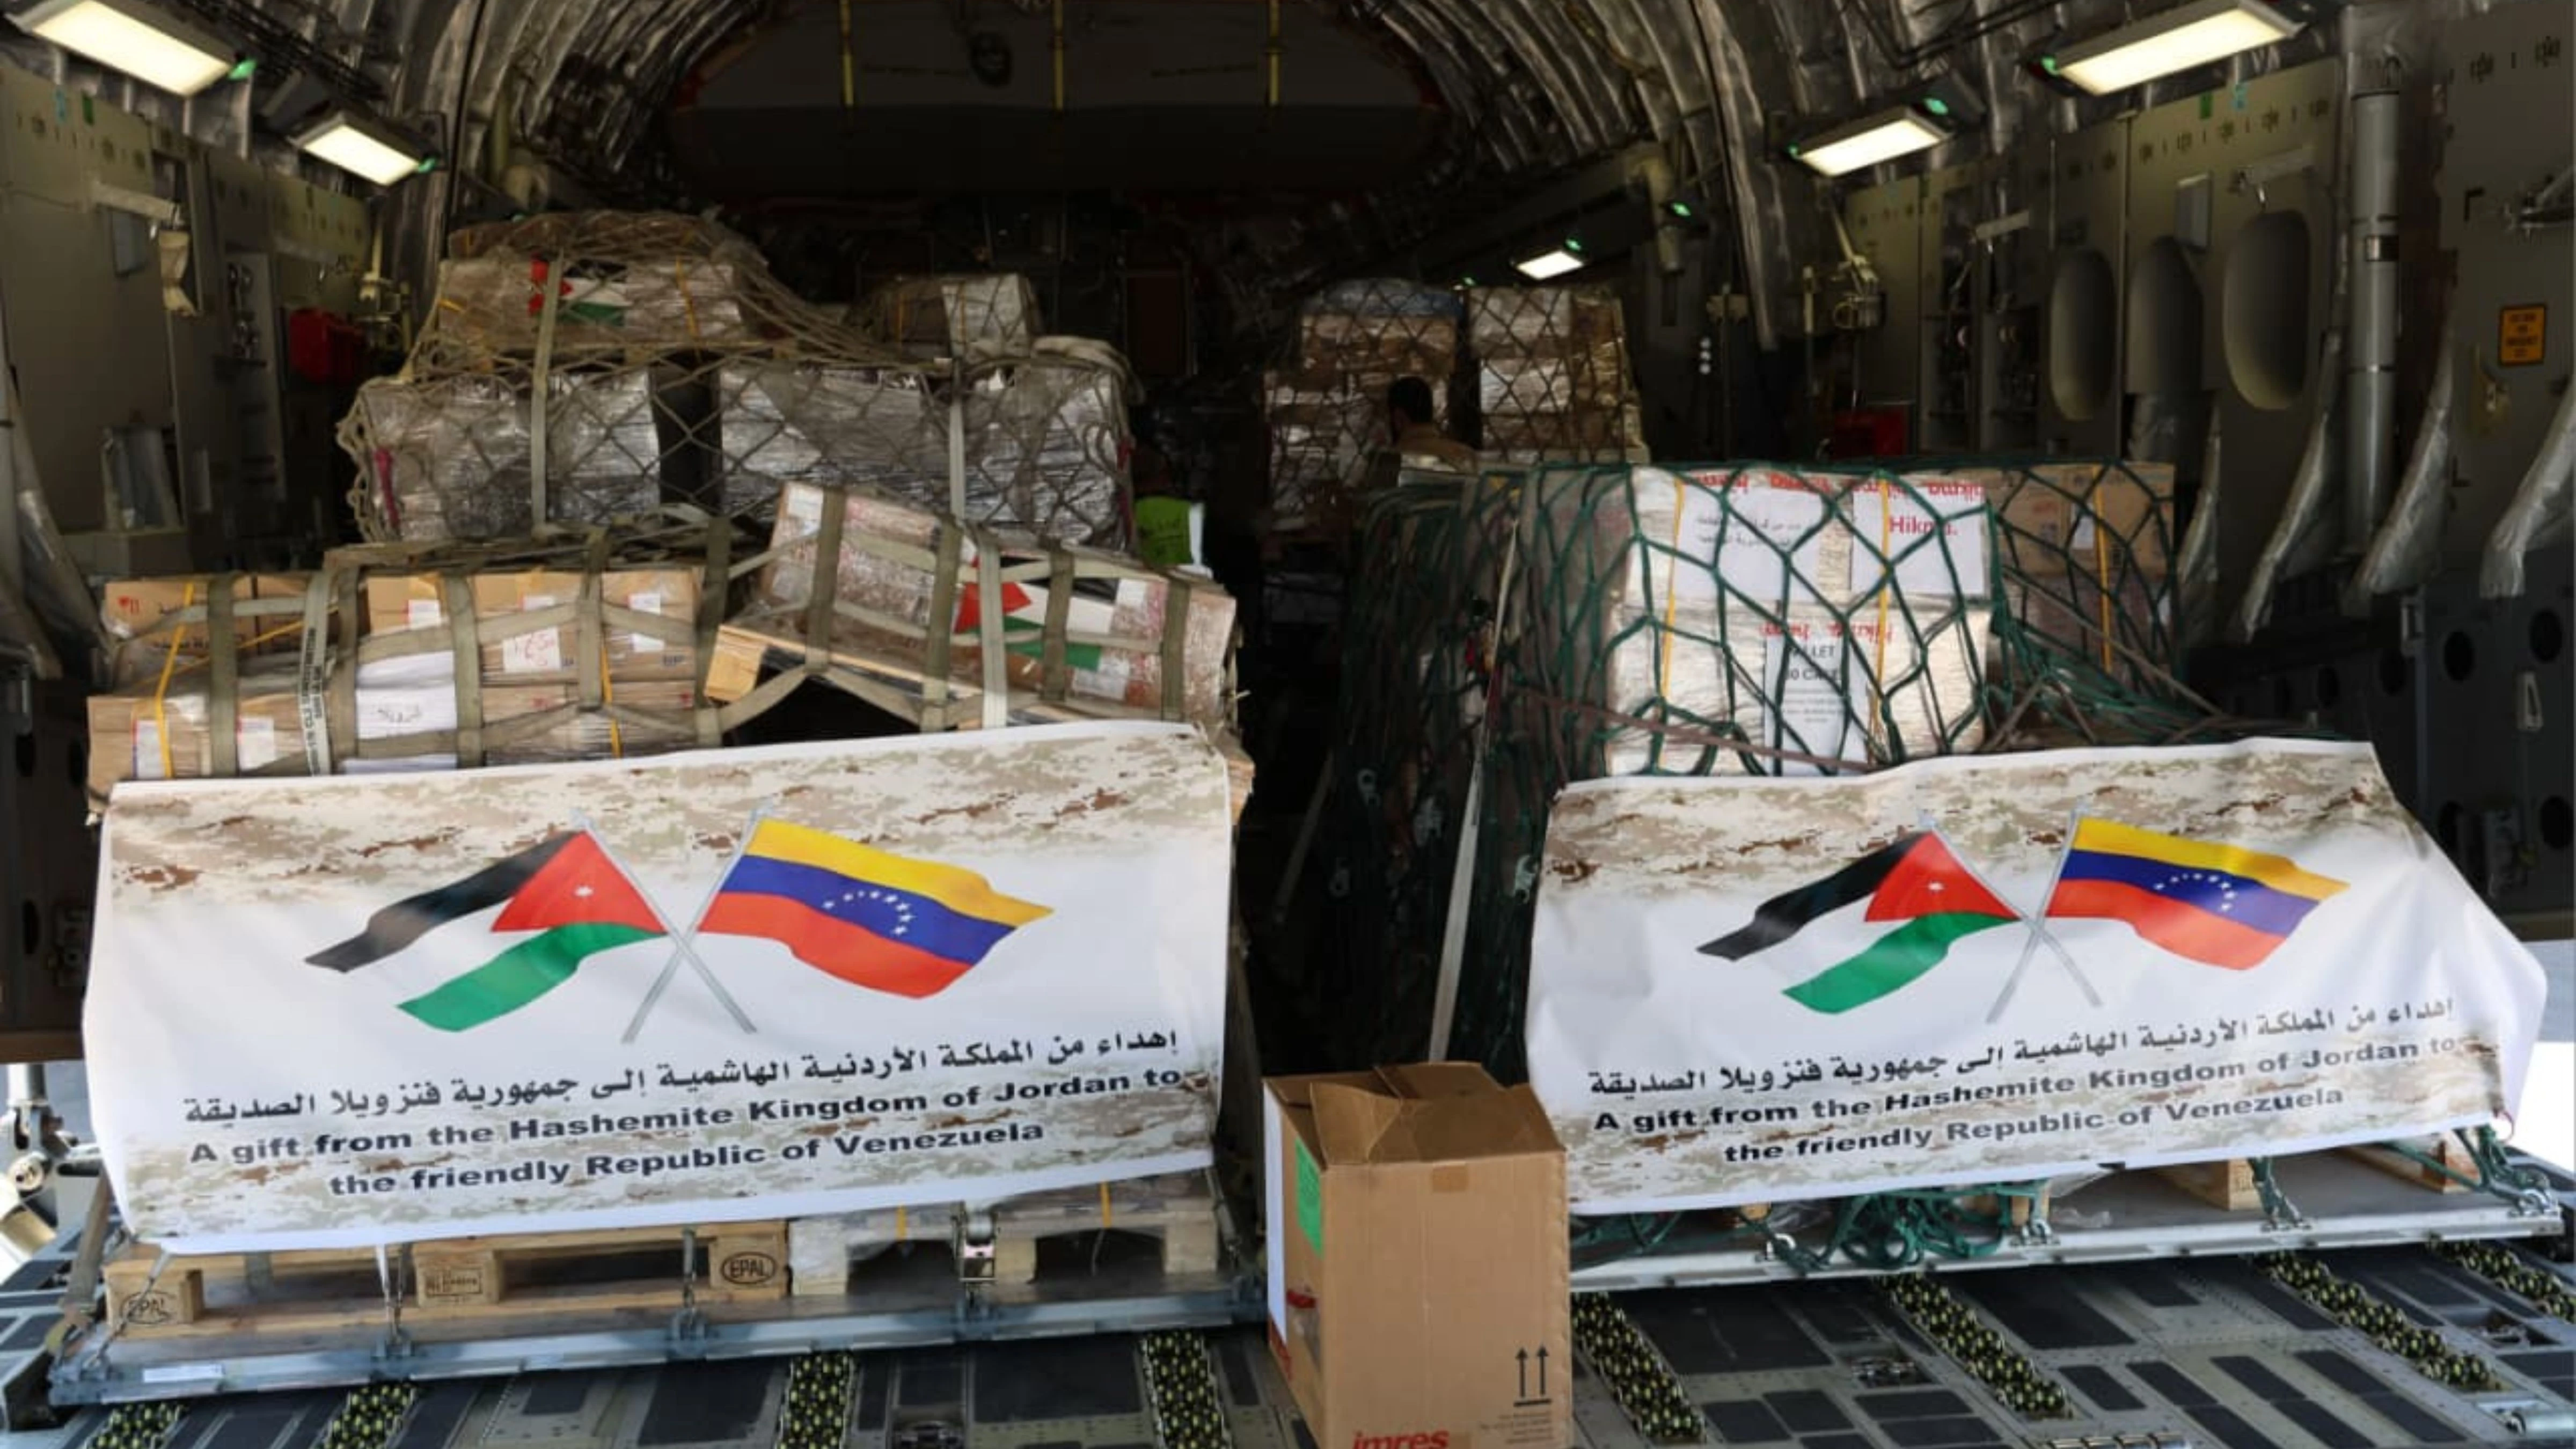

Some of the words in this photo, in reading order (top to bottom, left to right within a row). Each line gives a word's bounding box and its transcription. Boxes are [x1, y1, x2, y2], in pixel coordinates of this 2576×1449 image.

[2256, 1008, 2335, 1035] المملكة
[2346, 1005, 2376, 1032] من
[938, 1040, 1033, 1067] المملكة
[1048, 1036, 1084, 1065] من
[1097, 1030, 1178, 1056] إهداء
[2015, 1031, 2128, 1063] الهاشمية
[658, 1060, 789, 1092] الهاشمية
[801, 1046, 926, 1083] الأردنية
[1719, 1059, 1823, 1093] فنزويلا
[1832, 1055, 1946, 1084] جمهورية
[331, 1081, 441, 1116] فنزويلا
[453, 1078, 578, 1108] جمهورية
[591, 1068, 646, 1099] إلى
[1589, 1070, 1705, 1100] الصديقة
[1594, 1113, 1619, 1130] A
[1634, 1110, 1696, 1134] gift
[1710, 1107, 1797, 1126] from
[1812, 1100, 1871, 1118] the
[1884, 1075, 2075, 1112] Hashemite
[2089, 1063, 2244, 1092] Kingdom
[2258, 1053, 2288, 1072] of
[2302, 1043, 2419, 1068] Jordan
[2431, 1037, 2455, 1053] to
[186, 1093, 316, 1128] الصديقة
[191, 1144, 217, 1162] A
[232, 1137, 300, 1165] gift
[316, 1134, 411, 1154] from
[428, 1125, 493, 1146] the
[508, 1106, 733, 1139] Hashemite
[750, 1096, 927, 1122] Kingdom
[943, 1086, 979, 1107] of
[994, 1075, 1131, 1102] Jordan
[1144, 1069, 1181, 1087] to
[1725, 1145, 1783, 1161] the
[1796, 1127, 1932, 1156] friendly
[1947, 1113, 2103, 1141] Republic
[2119, 1106, 2151, 1125] of
[2165, 1087, 2343, 1122] Venezuela
[331, 1172, 394, 1196] the
[411, 1159, 570, 1189] friendly
[588, 1147, 766, 1176] Republic
[782, 1139, 819, 1159] of
[834, 1123, 1043, 1155] Venezuela
[730, 1259, 770, 1278] EPAL
[1353, 1430, 1449, 1449] imres
